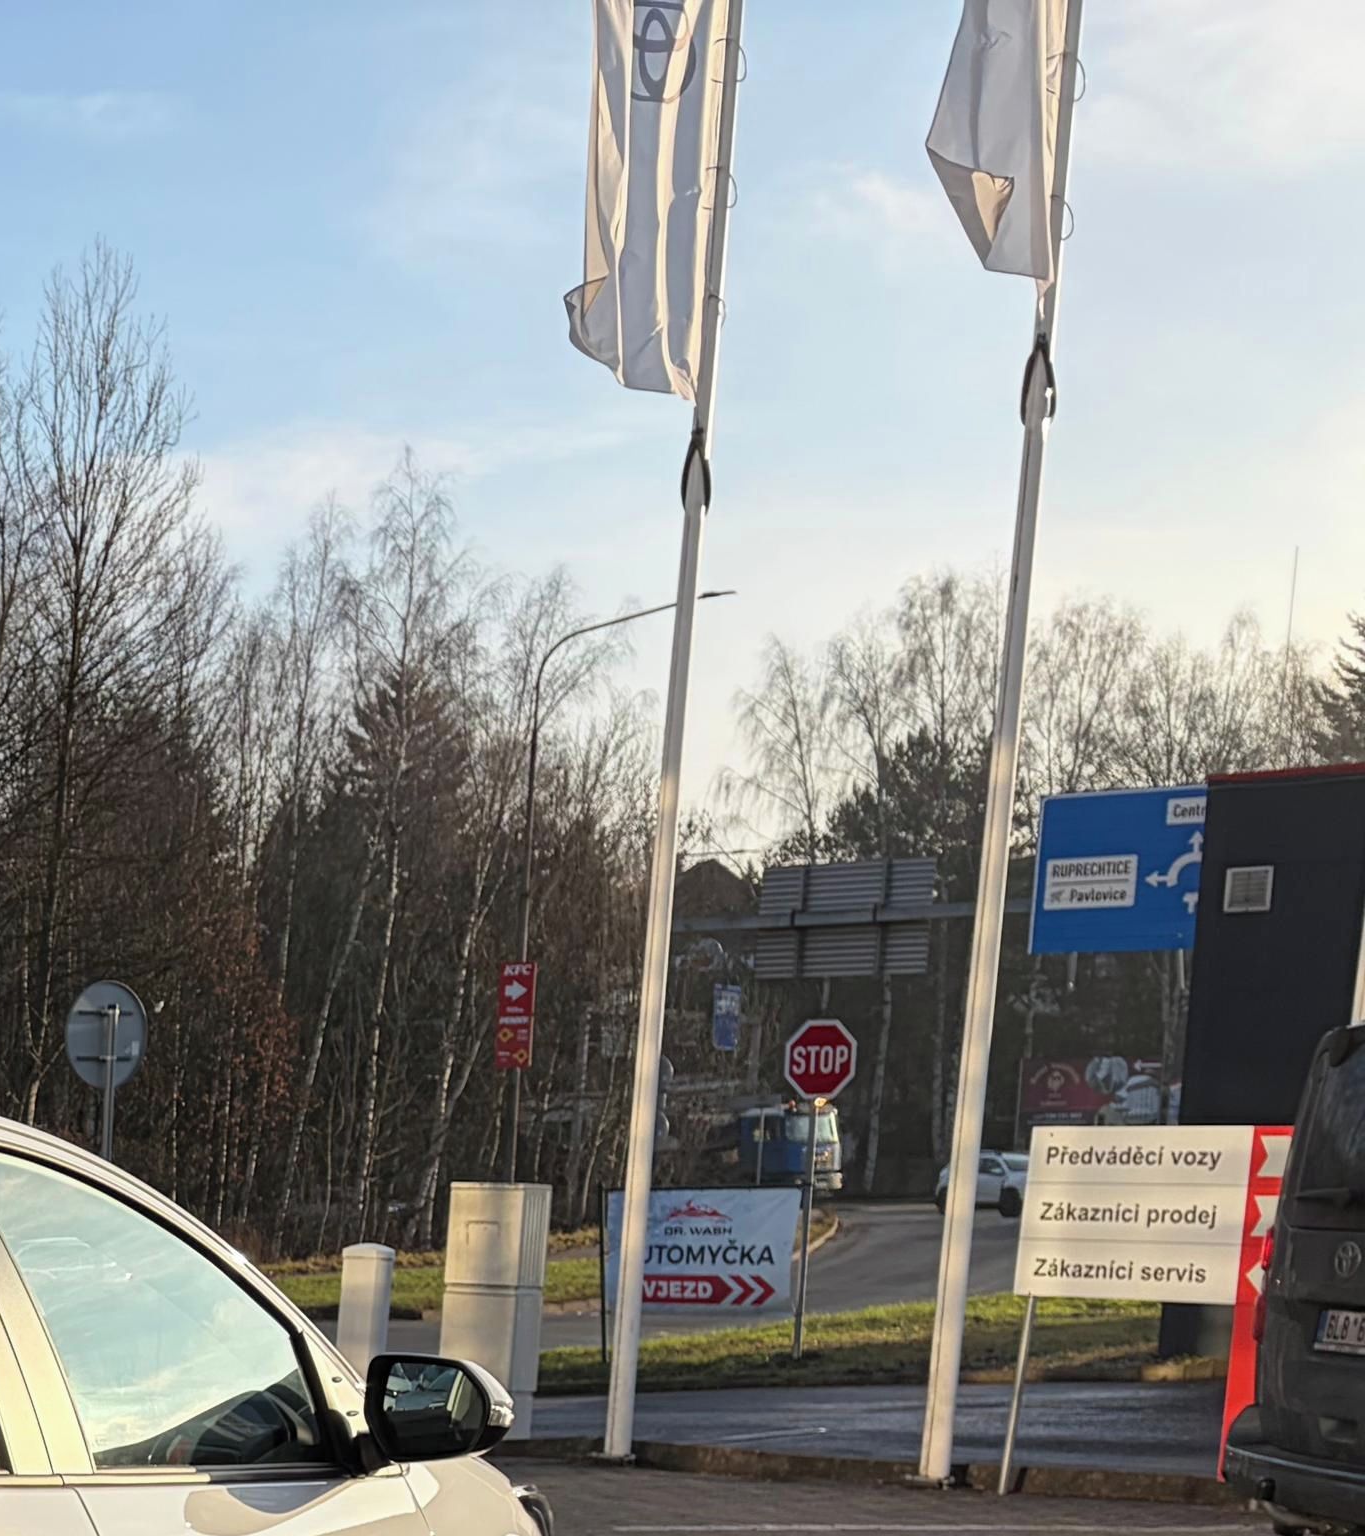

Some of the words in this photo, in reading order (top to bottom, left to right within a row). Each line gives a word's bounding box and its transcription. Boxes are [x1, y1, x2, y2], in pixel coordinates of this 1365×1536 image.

[1052, 860, 1132, 877] RUPRECHTICE
[1069, 887, 1127, 902] Pavlovice
[504, 963, 532, 976] KFC
[792, 1045, 849, 1075] STOP
[1045, 1146, 1165, 1166] Předváděcí
[1171, 1150, 1222, 1171] vozy
[1039, 1202, 1140, 1223] Zákazníci
[1146, 1205, 1218, 1229] prodej
[644, 1239, 775, 1265] UTOMYČKA
[1033, 1257, 1134, 1280] Zákazníci
[1140, 1262, 1207, 1283] servis
[643, 1280, 714, 1299] VJEZD
